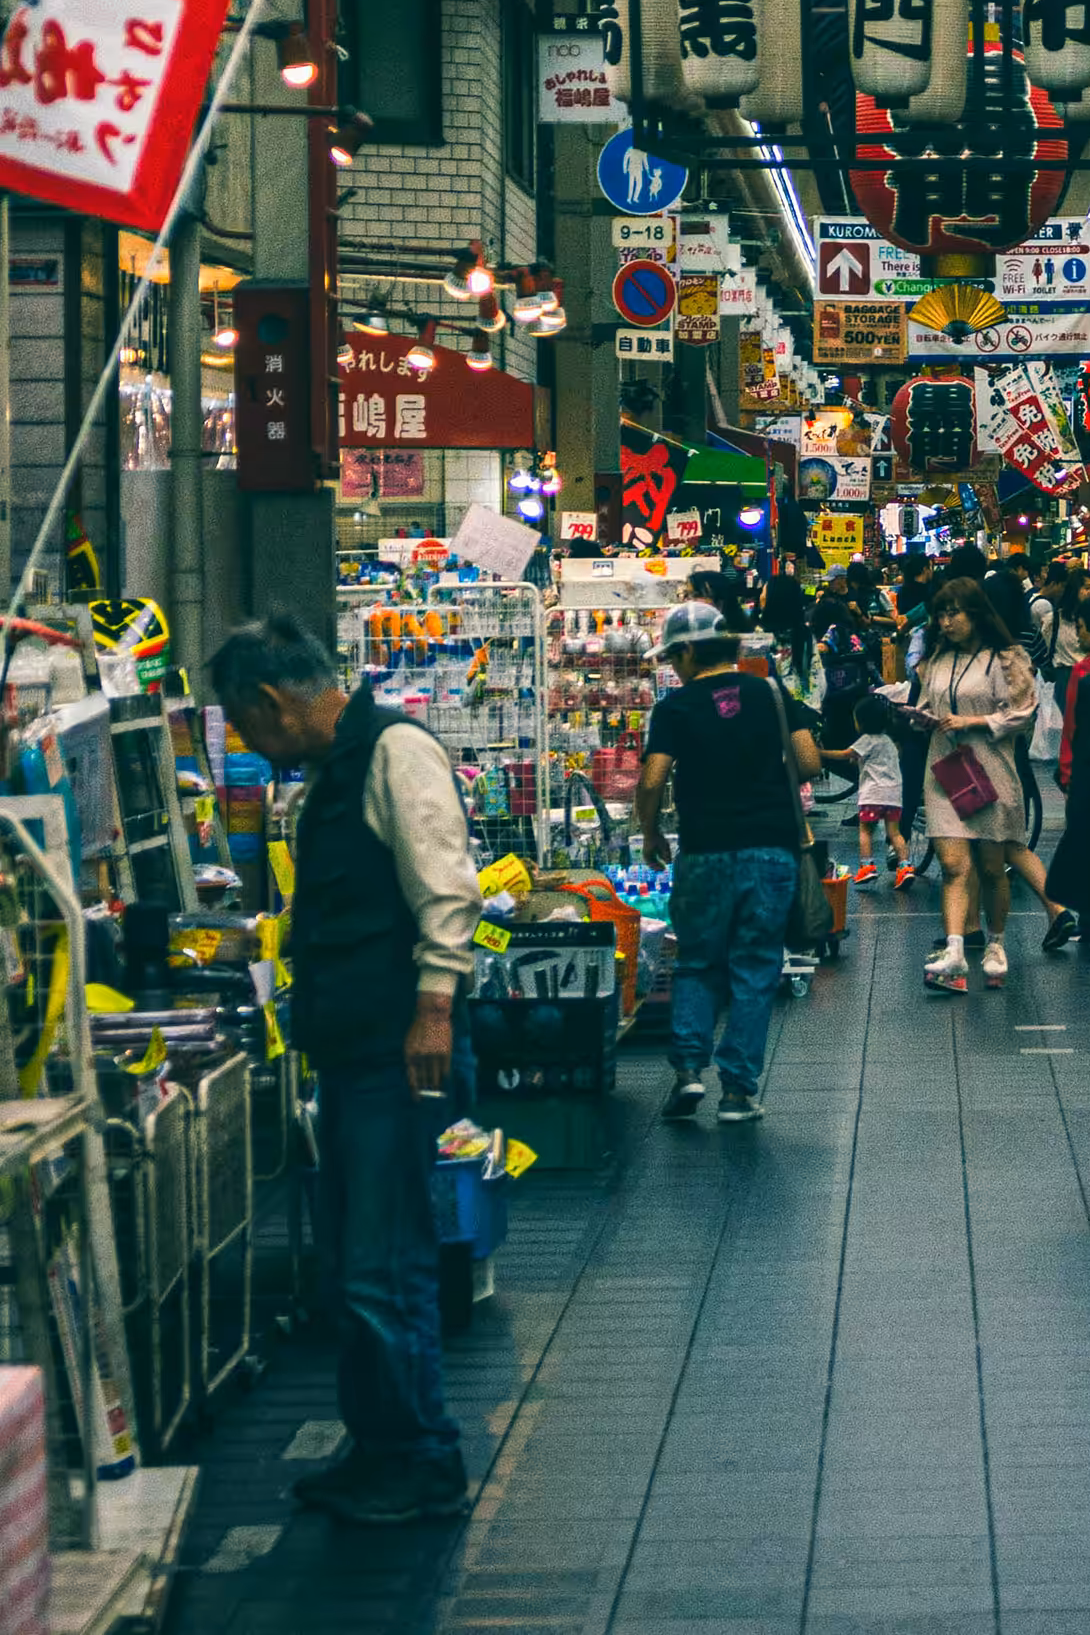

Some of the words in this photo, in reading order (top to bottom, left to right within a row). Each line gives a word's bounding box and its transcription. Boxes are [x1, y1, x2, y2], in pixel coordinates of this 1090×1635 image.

[554, 87, 611, 108] 福嶋屋
[619, 224, 665, 240] 9-18
[881, 261, 910, 272] There
[1003, 273, 1025, 283] FREE
[1003, 284, 1026, 294] Wi-Fi
[844, 305, 900, 314] BAGGAGE
[844, 315, 900, 324] STORAGE
[678, 321, 717, 330] STAMP
[1034, 333, 1088, 343] バイク通行禁止
[618, 336, 671, 353] 自動車
[264, 353, 286, 440] 消火器
[339, 394, 427, 439] 嶋屋
[568, 523, 594, 538] 799
[676, 521, 698, 536] 799
[822, 534, 857, 543] Lunch
